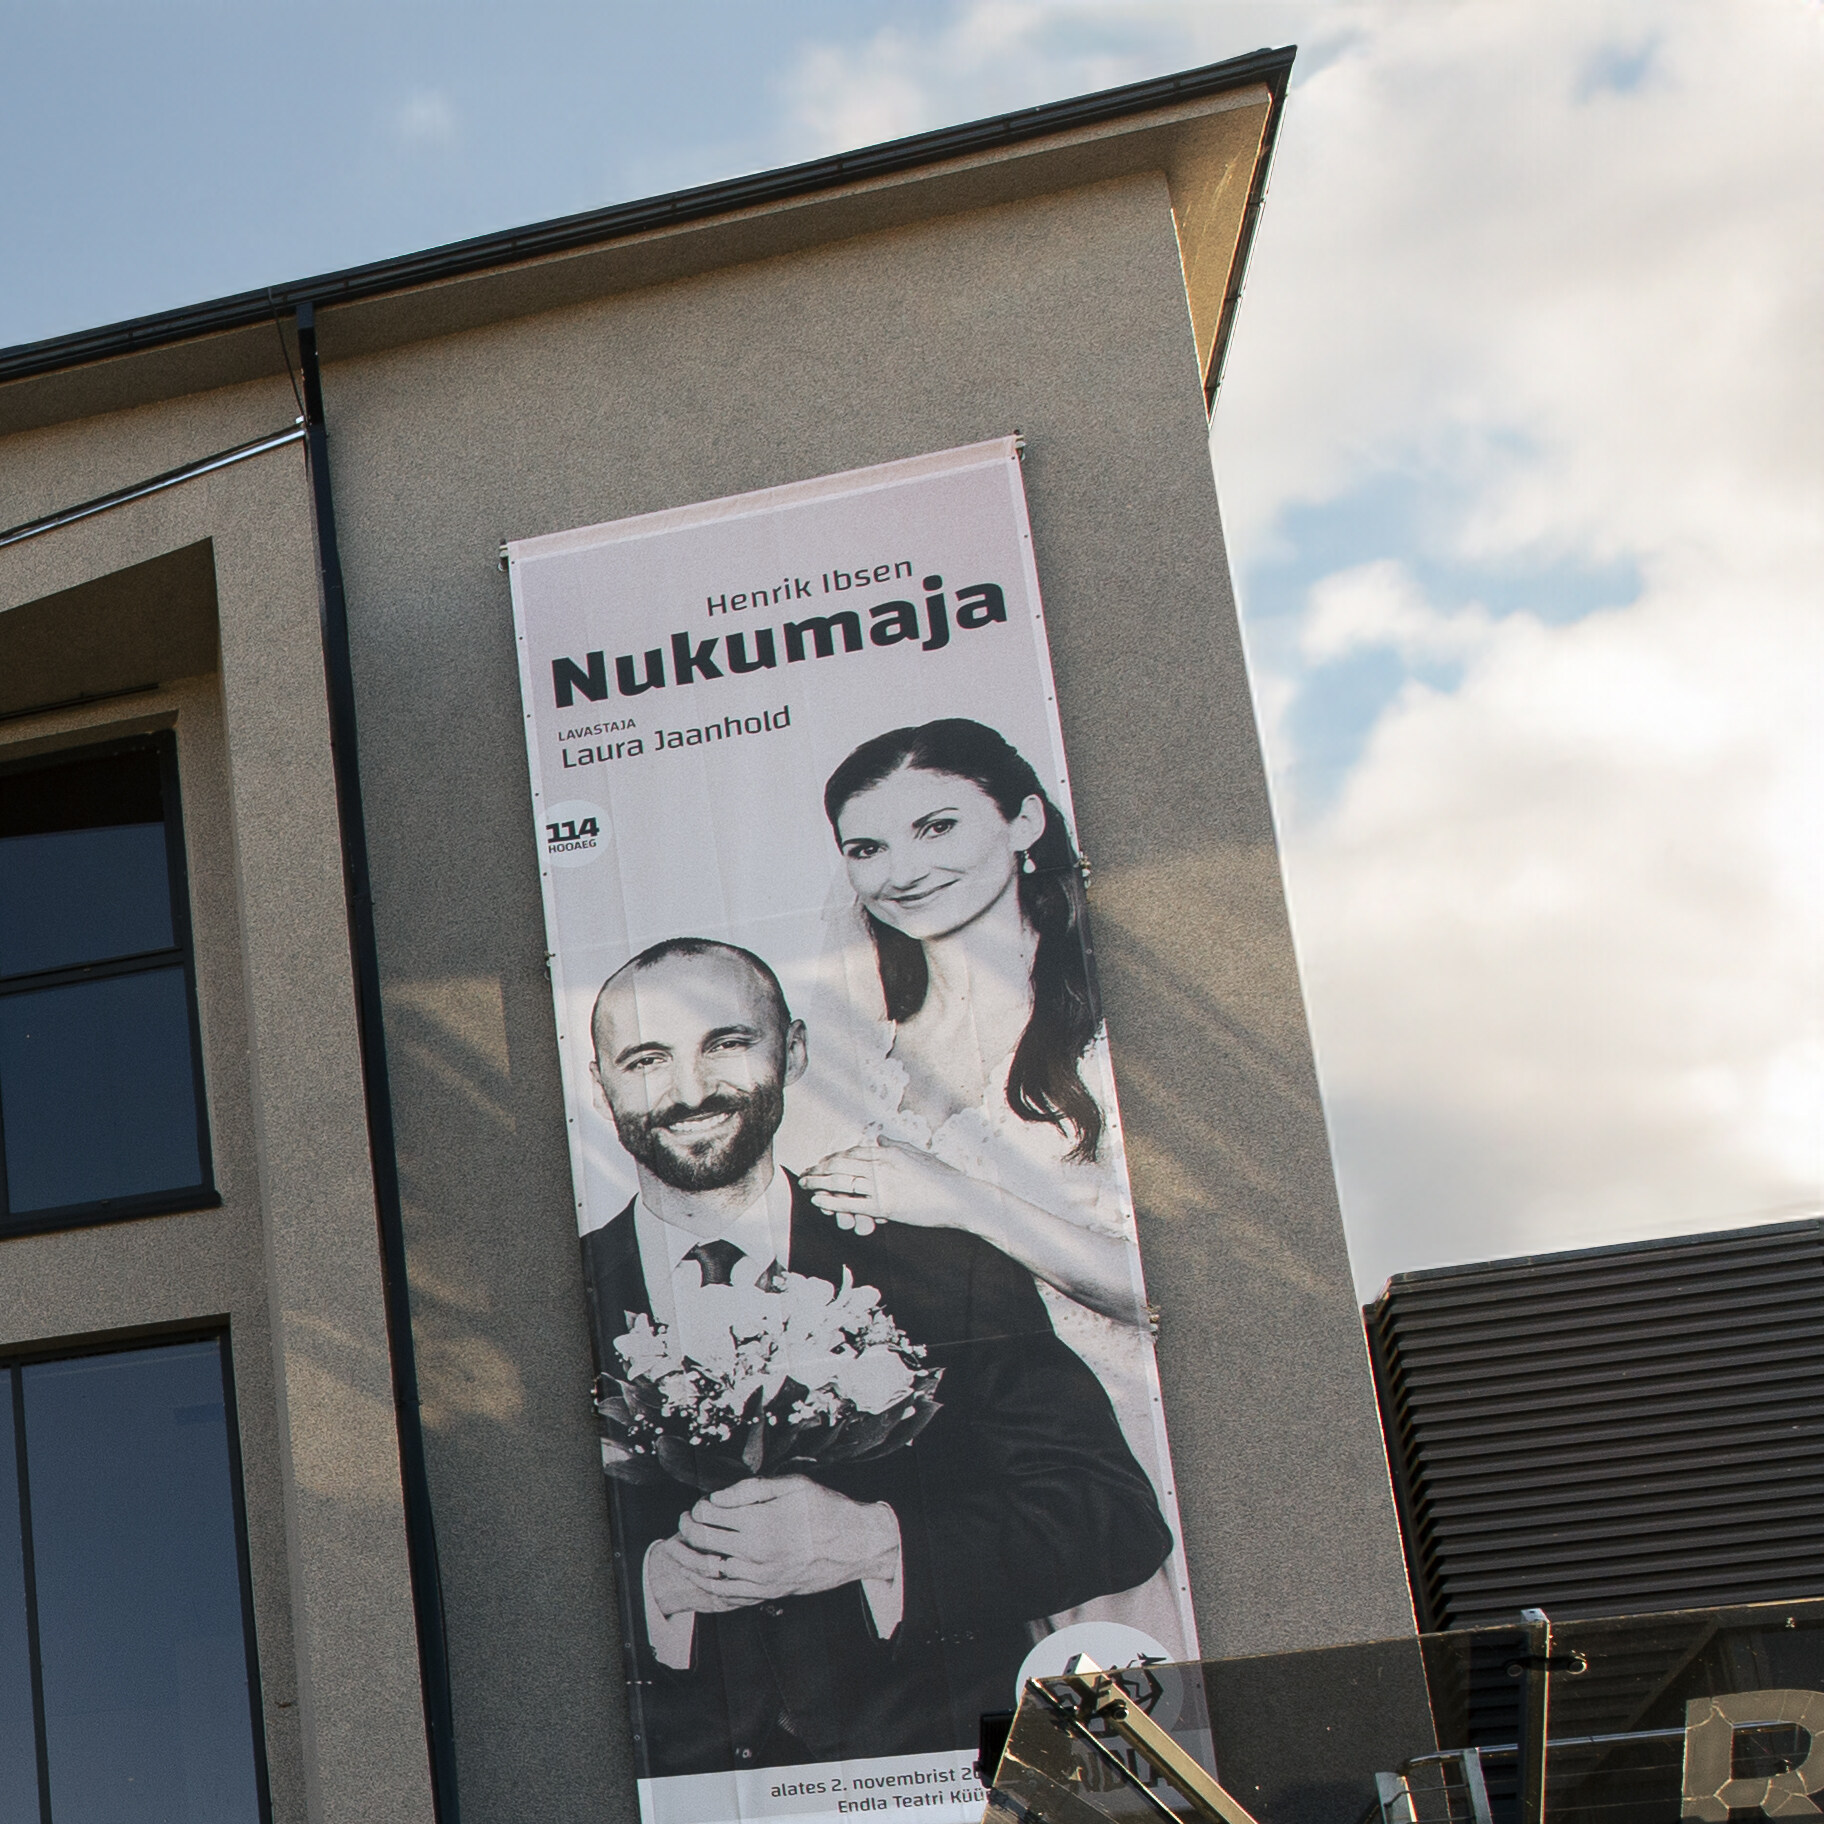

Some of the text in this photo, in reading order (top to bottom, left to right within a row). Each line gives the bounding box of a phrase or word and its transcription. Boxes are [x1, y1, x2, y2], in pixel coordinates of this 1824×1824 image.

[707, 560, 914, 617] Henrik Ibsen
[551, 575, 1008, 708] Nukumaja
[558, 718, 636, 741] LAVASTAJA
[562, 705, 791, 768] Laura Jaanhold
[546, 817, 600, 843] 114
[549, 839, 597, 853] HOOAEG
[770, 1779, 827, 1797] alates
[831, 1778, 847, 1792] 2.
[852, 1768, 956, 1790] novembrist
[838, 1797, 887, 1814] Endla
[892, 1790, 944, 1809] Teatri
